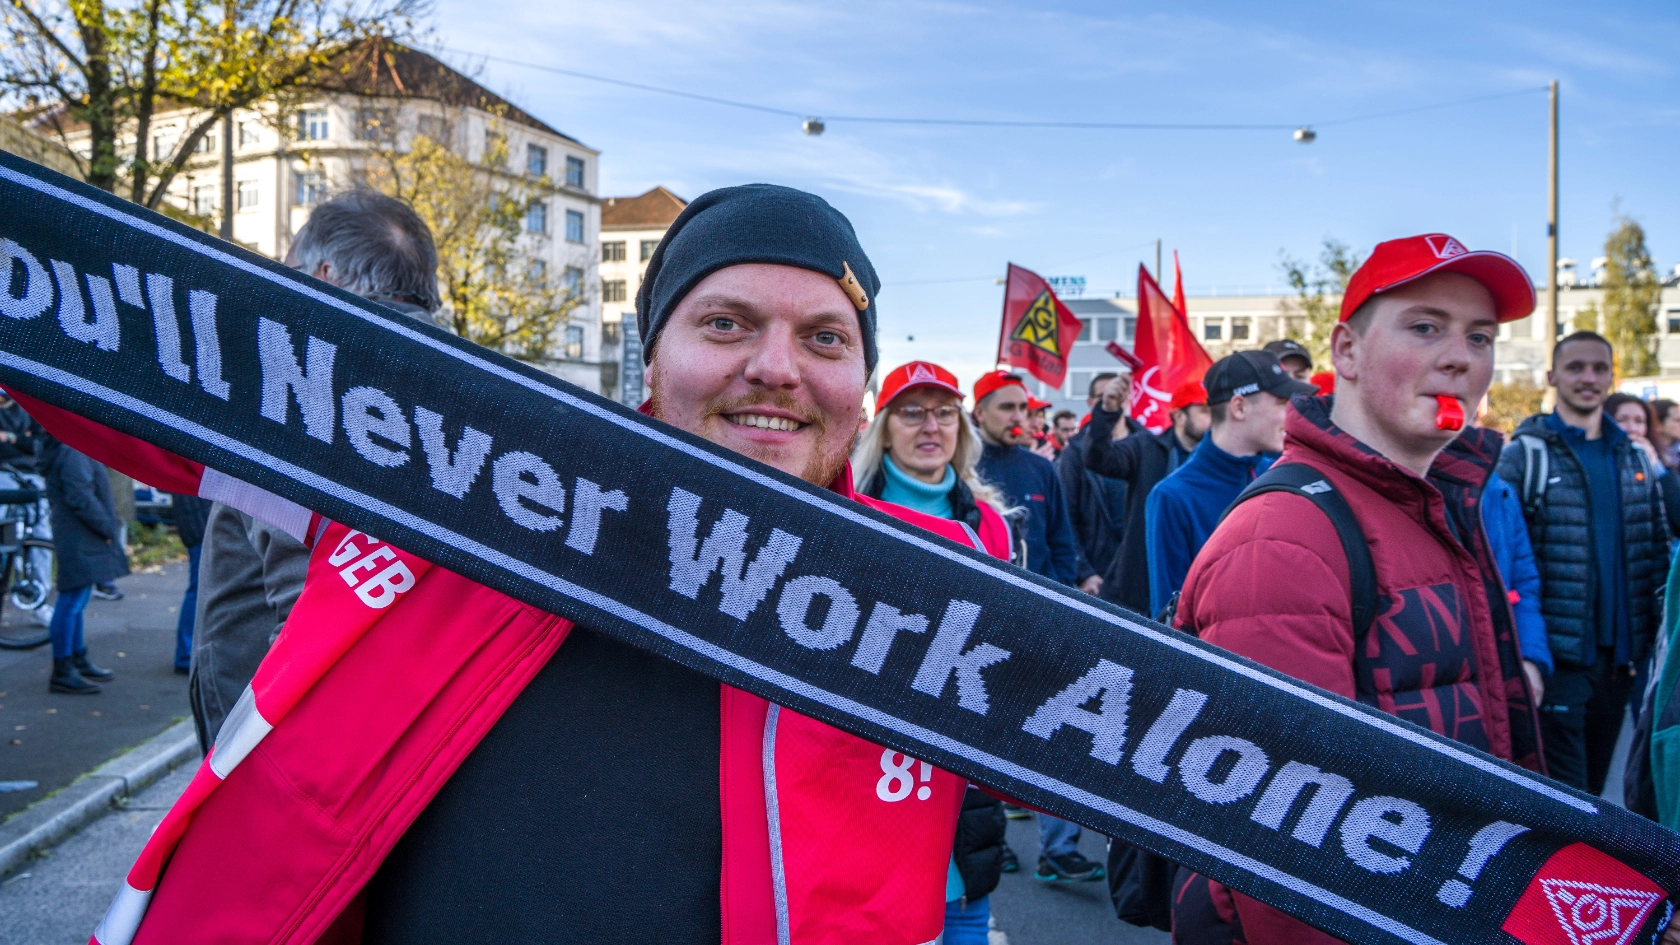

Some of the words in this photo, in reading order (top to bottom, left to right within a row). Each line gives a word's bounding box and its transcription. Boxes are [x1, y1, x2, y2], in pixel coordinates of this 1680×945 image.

[1046, 276, 1086, 286] MENS
[328, 528, 416, 609] GEB
[259, 317, 630, 555] Never
[667, 486, 1012, 716] Work
[1023, 658, 1530, 908] Alone!
[876, 747, 933, 803] 8!
